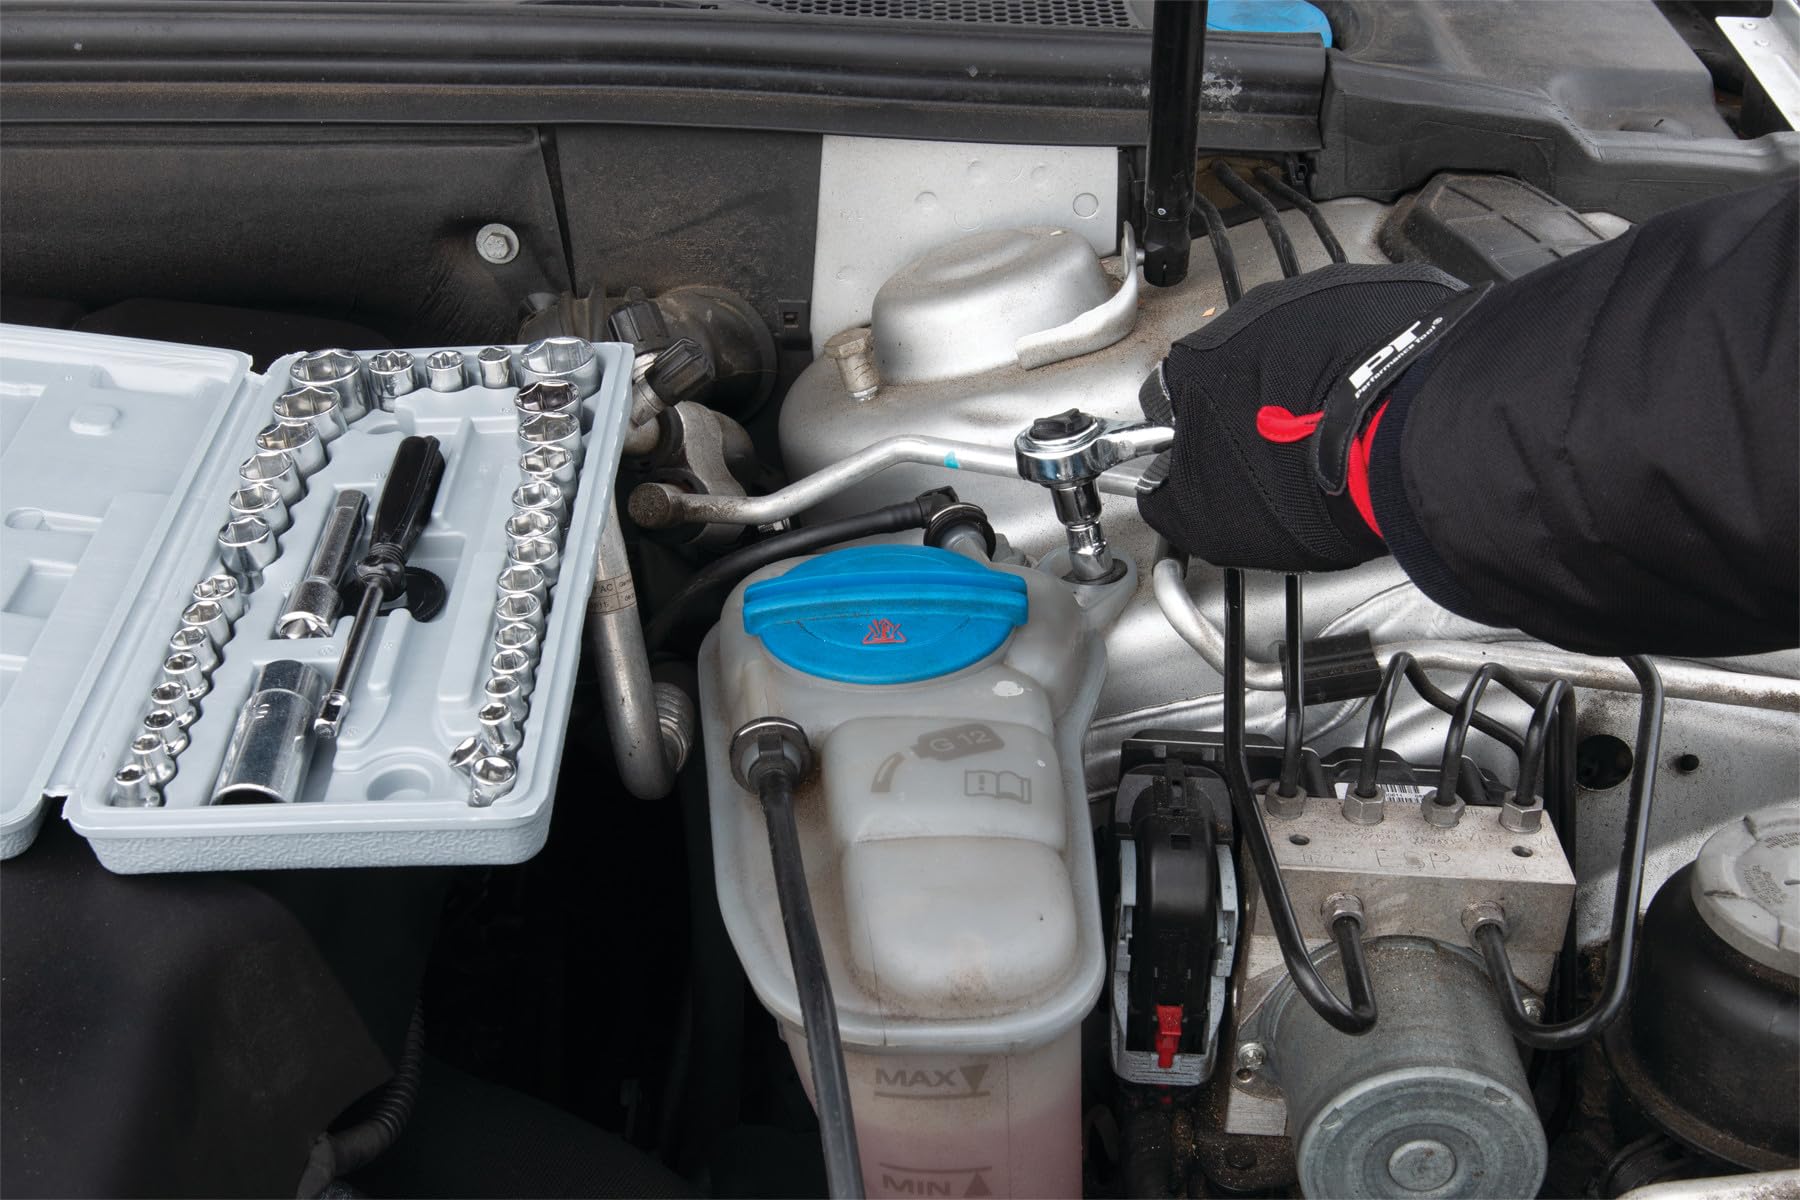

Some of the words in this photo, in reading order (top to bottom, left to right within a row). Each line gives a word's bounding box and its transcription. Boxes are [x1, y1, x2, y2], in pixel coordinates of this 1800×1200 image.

[1348, 320, 1421, 389] PT
[875, 1067, 957, 1088] MAX
[882, 1173, 952, 1197] MIN
